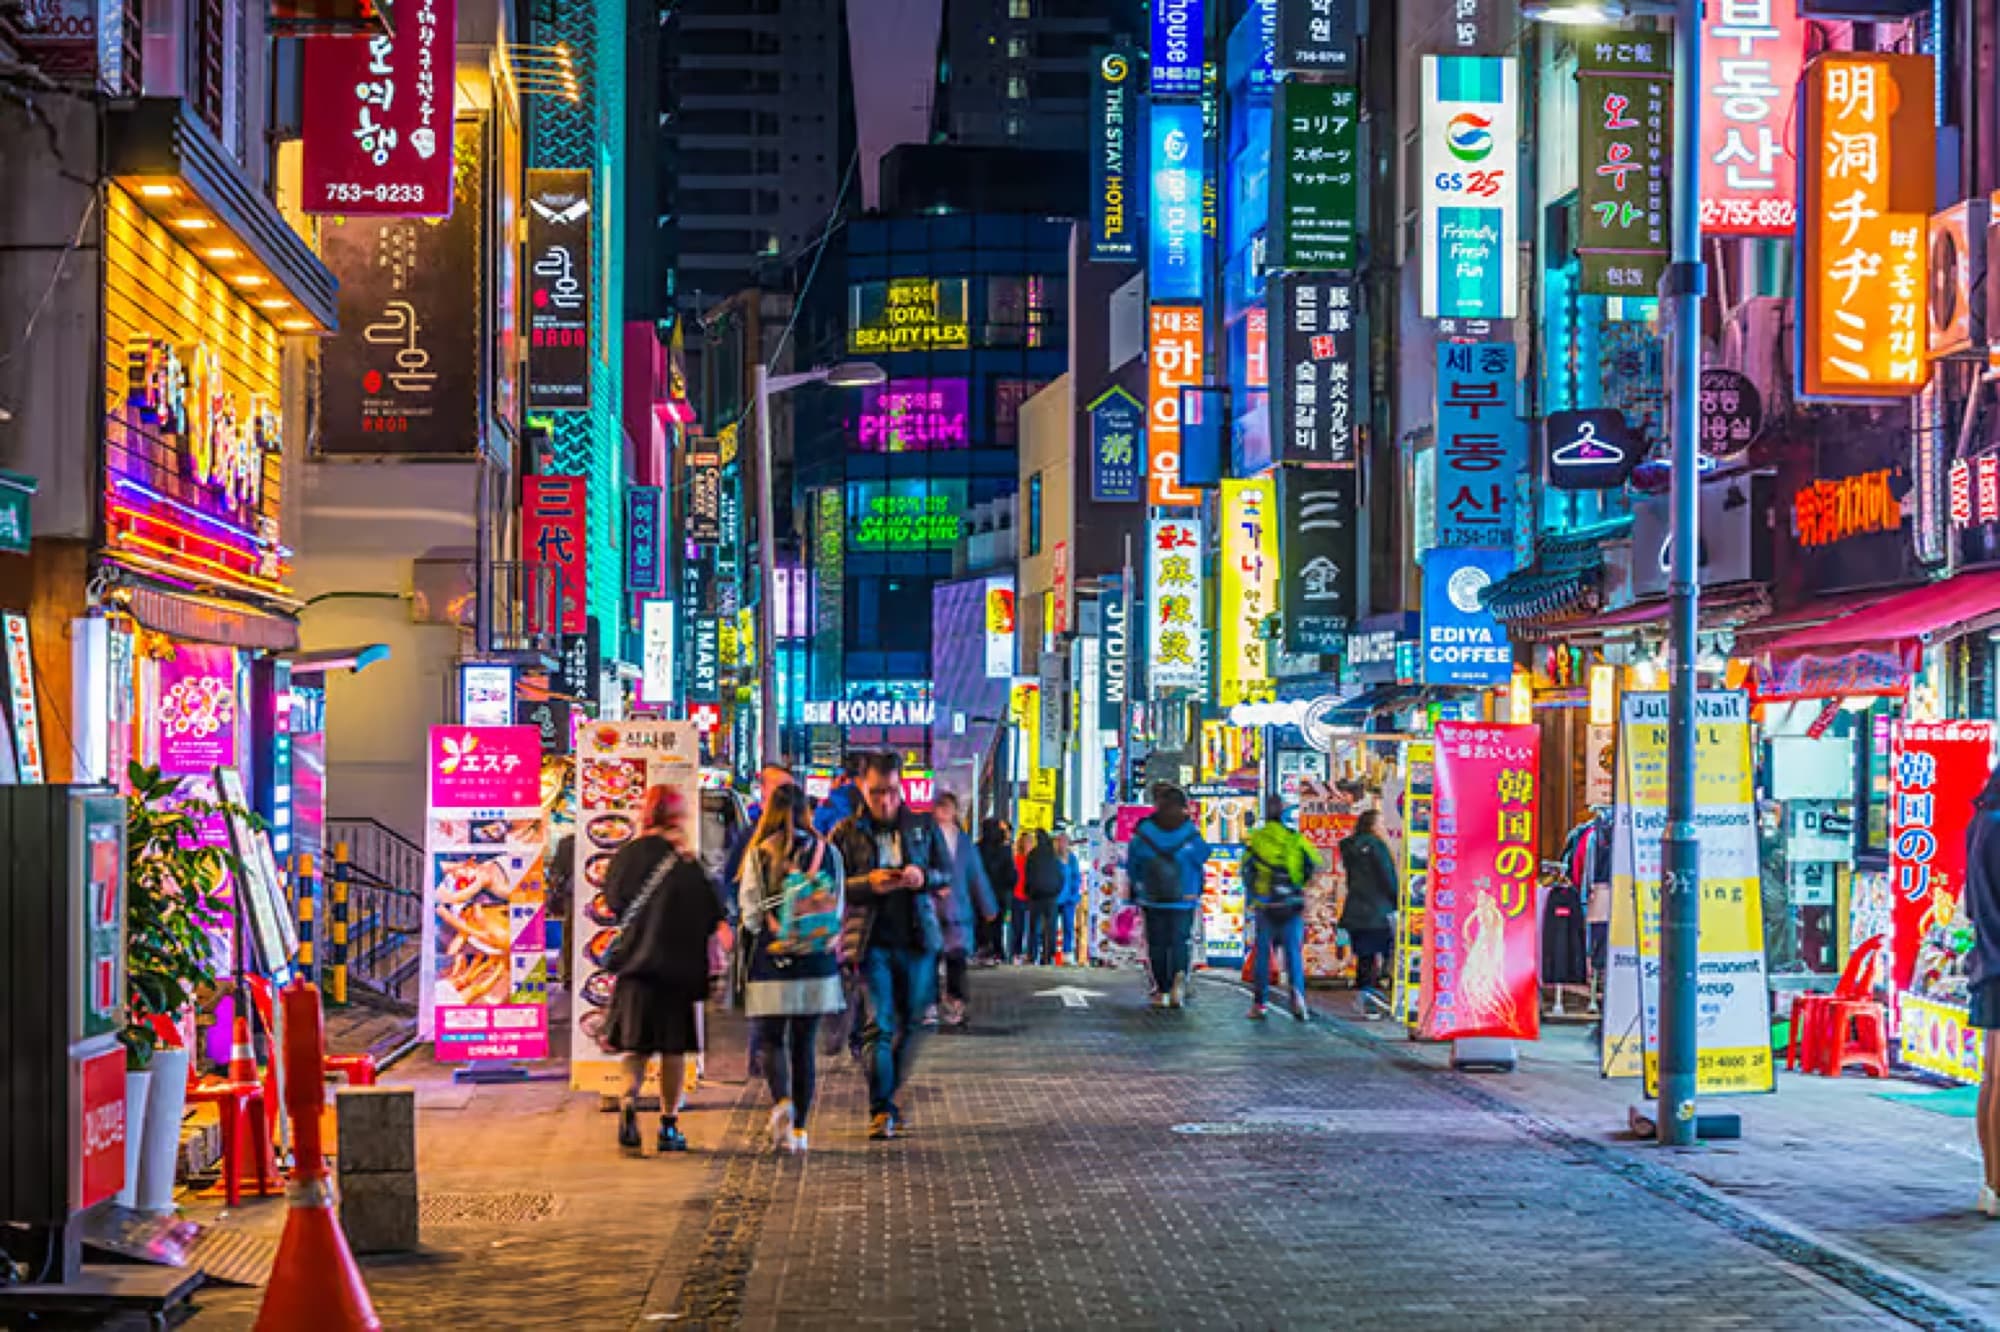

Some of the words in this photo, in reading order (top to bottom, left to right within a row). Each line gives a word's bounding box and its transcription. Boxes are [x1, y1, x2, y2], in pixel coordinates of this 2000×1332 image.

[1105, 88, 1124, 124] THE
[1711, 0, 1784, 190] 부동산
[1105, 126, 1124, 174] STAY
[1293, 115, 1350, 134] コリア
[1105, 176, 1124, 239] HOTEL
[1826, 65, 1882, 380] 明洞チヂミ
[1443, 382, 1508, 523] 부동산
[535, 482, 575, 563] 三代
[1430, 626, 1493, 643] EDIYA
[1430, 645, 1511, 664] COFFEE
[837, 699, 906, 724] KOREA
[462, 754, 522, 774] エステ
[1495, 768, 1535, 919] 韓国のり
[1897, 752, 1937, 900] 韓国のり
